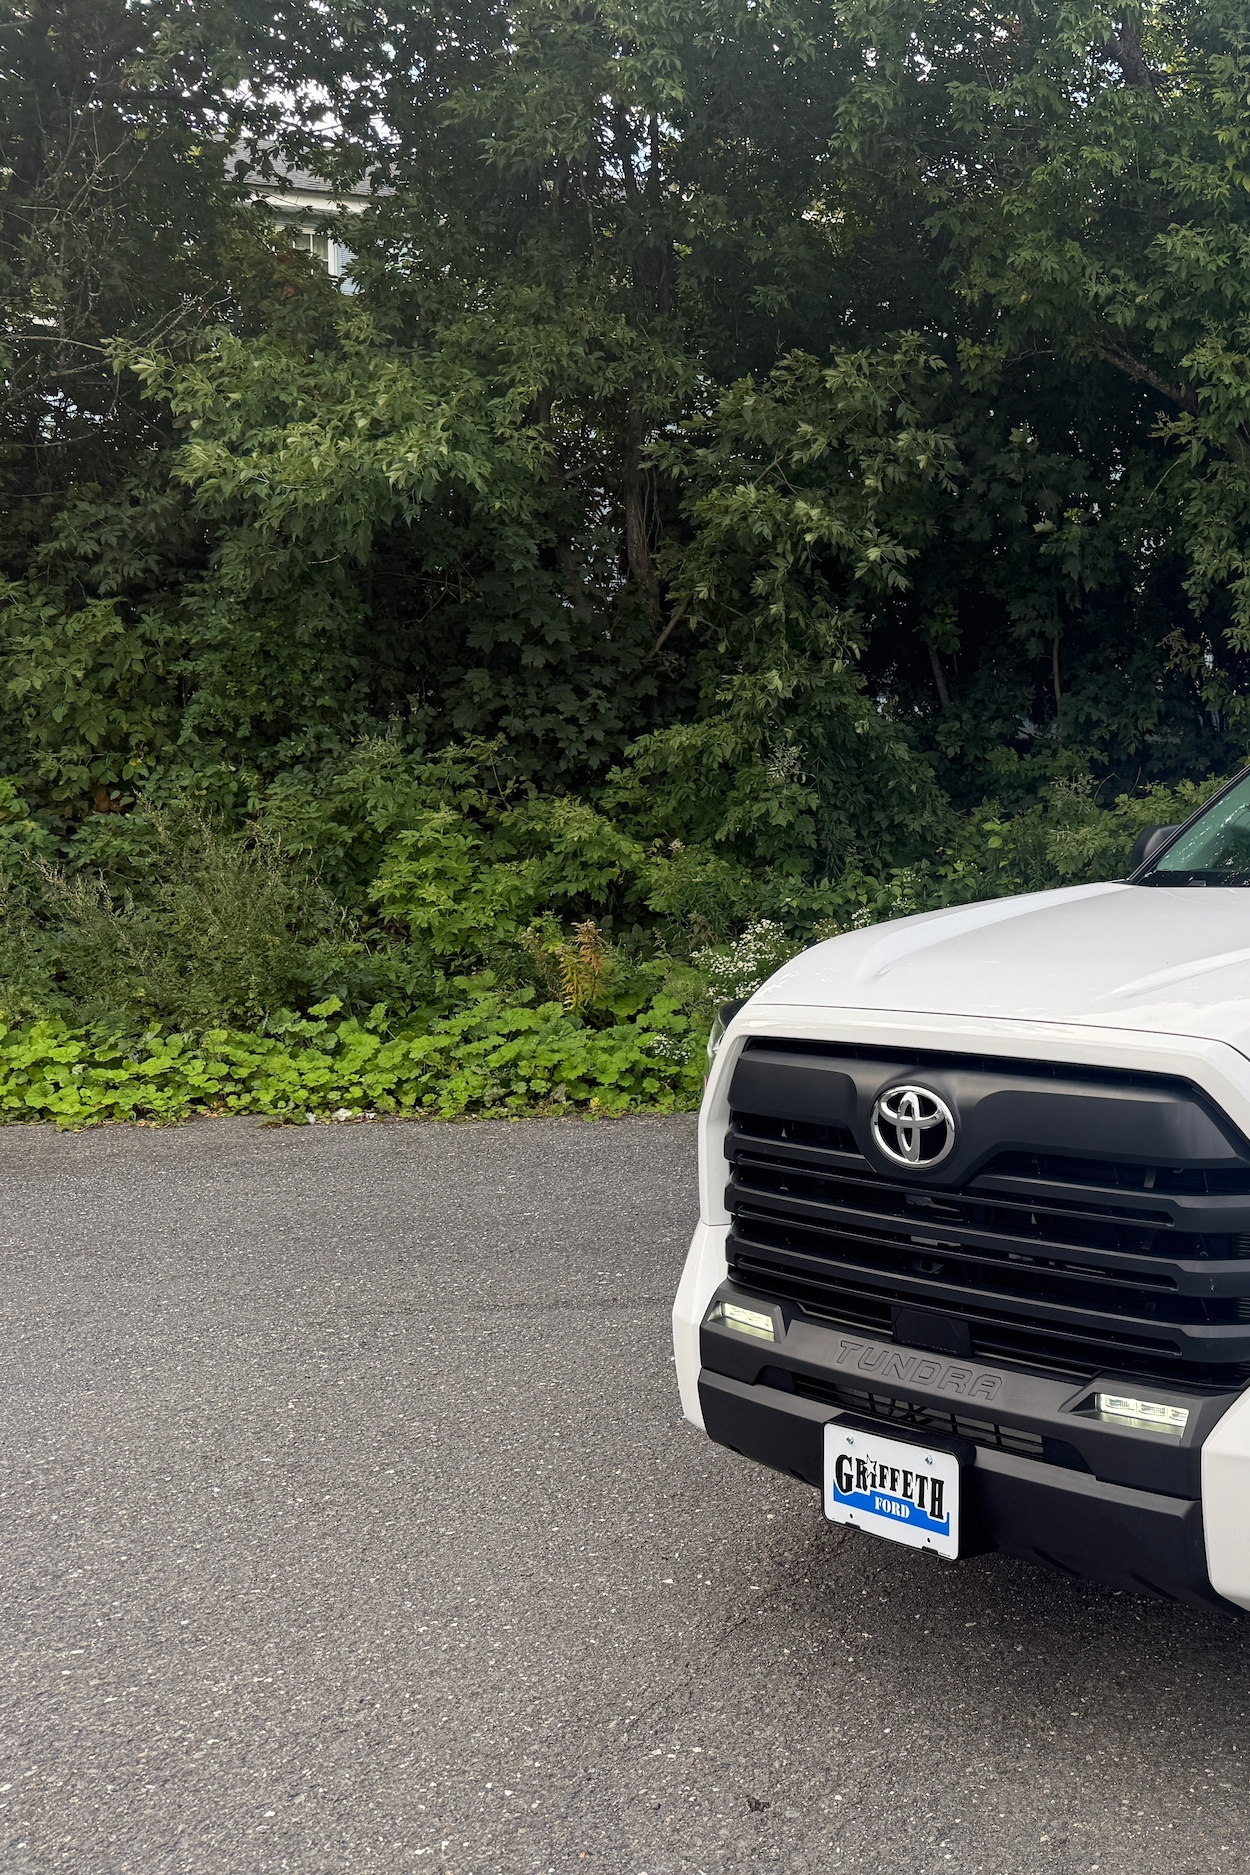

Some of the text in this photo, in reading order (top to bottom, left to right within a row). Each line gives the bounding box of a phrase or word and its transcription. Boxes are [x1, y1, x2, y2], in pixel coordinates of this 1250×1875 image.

[836, 1339, 1003, 1401] TUNDRA
[835, 1454, 945, 1520] GRIFFETH
[875, 1496, 911, 1519] FORD
